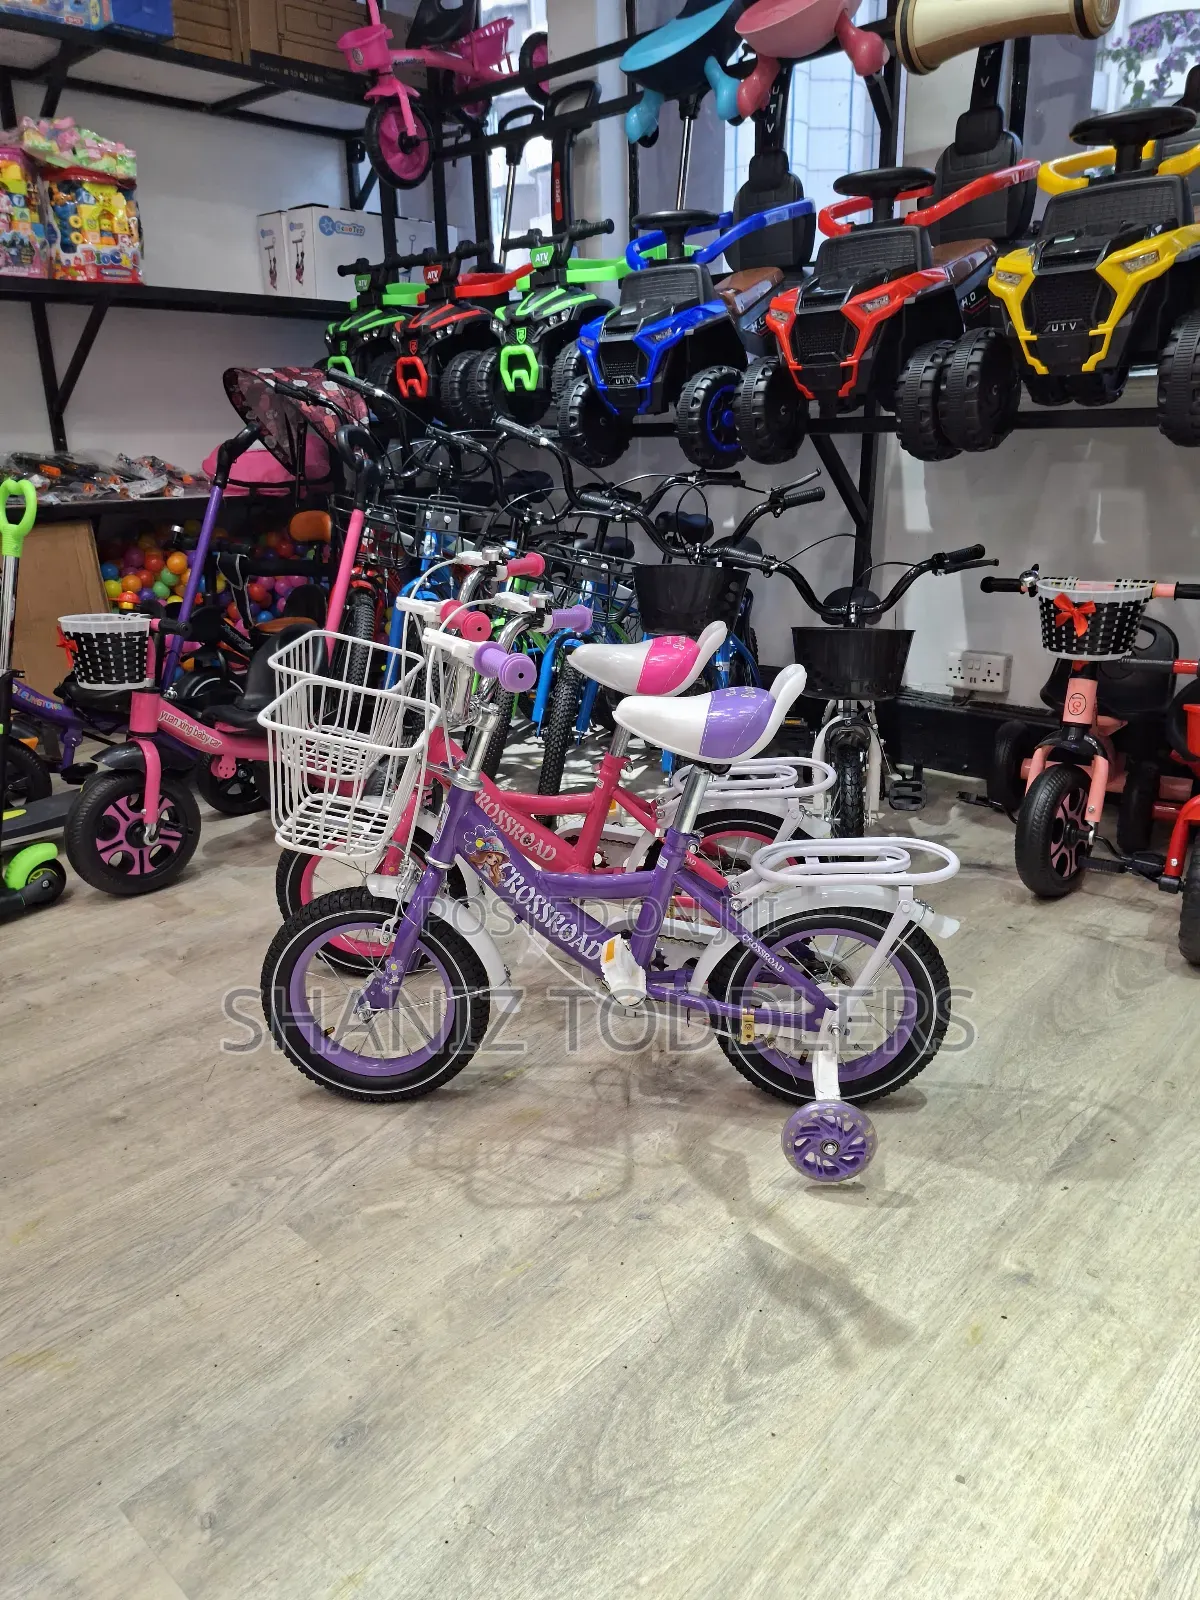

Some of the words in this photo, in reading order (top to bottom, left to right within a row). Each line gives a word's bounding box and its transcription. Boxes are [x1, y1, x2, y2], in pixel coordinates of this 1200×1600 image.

[427, 270, 439, 280] ATV
[535, 251, 549, 262] ATV
[1051, 321, 1077, 332] UTV
[159, 710, 180, 726] yuan
[178, 719, 194, 736] xing
[193, 726, 211, 744] baby
[209, 737, 222, 748] car
[475, 789, 557, 861] ROSSROAD
[500, 862, 603, 960] CROSSROAD
[742, 934, 785, 973] CROSSROAD
